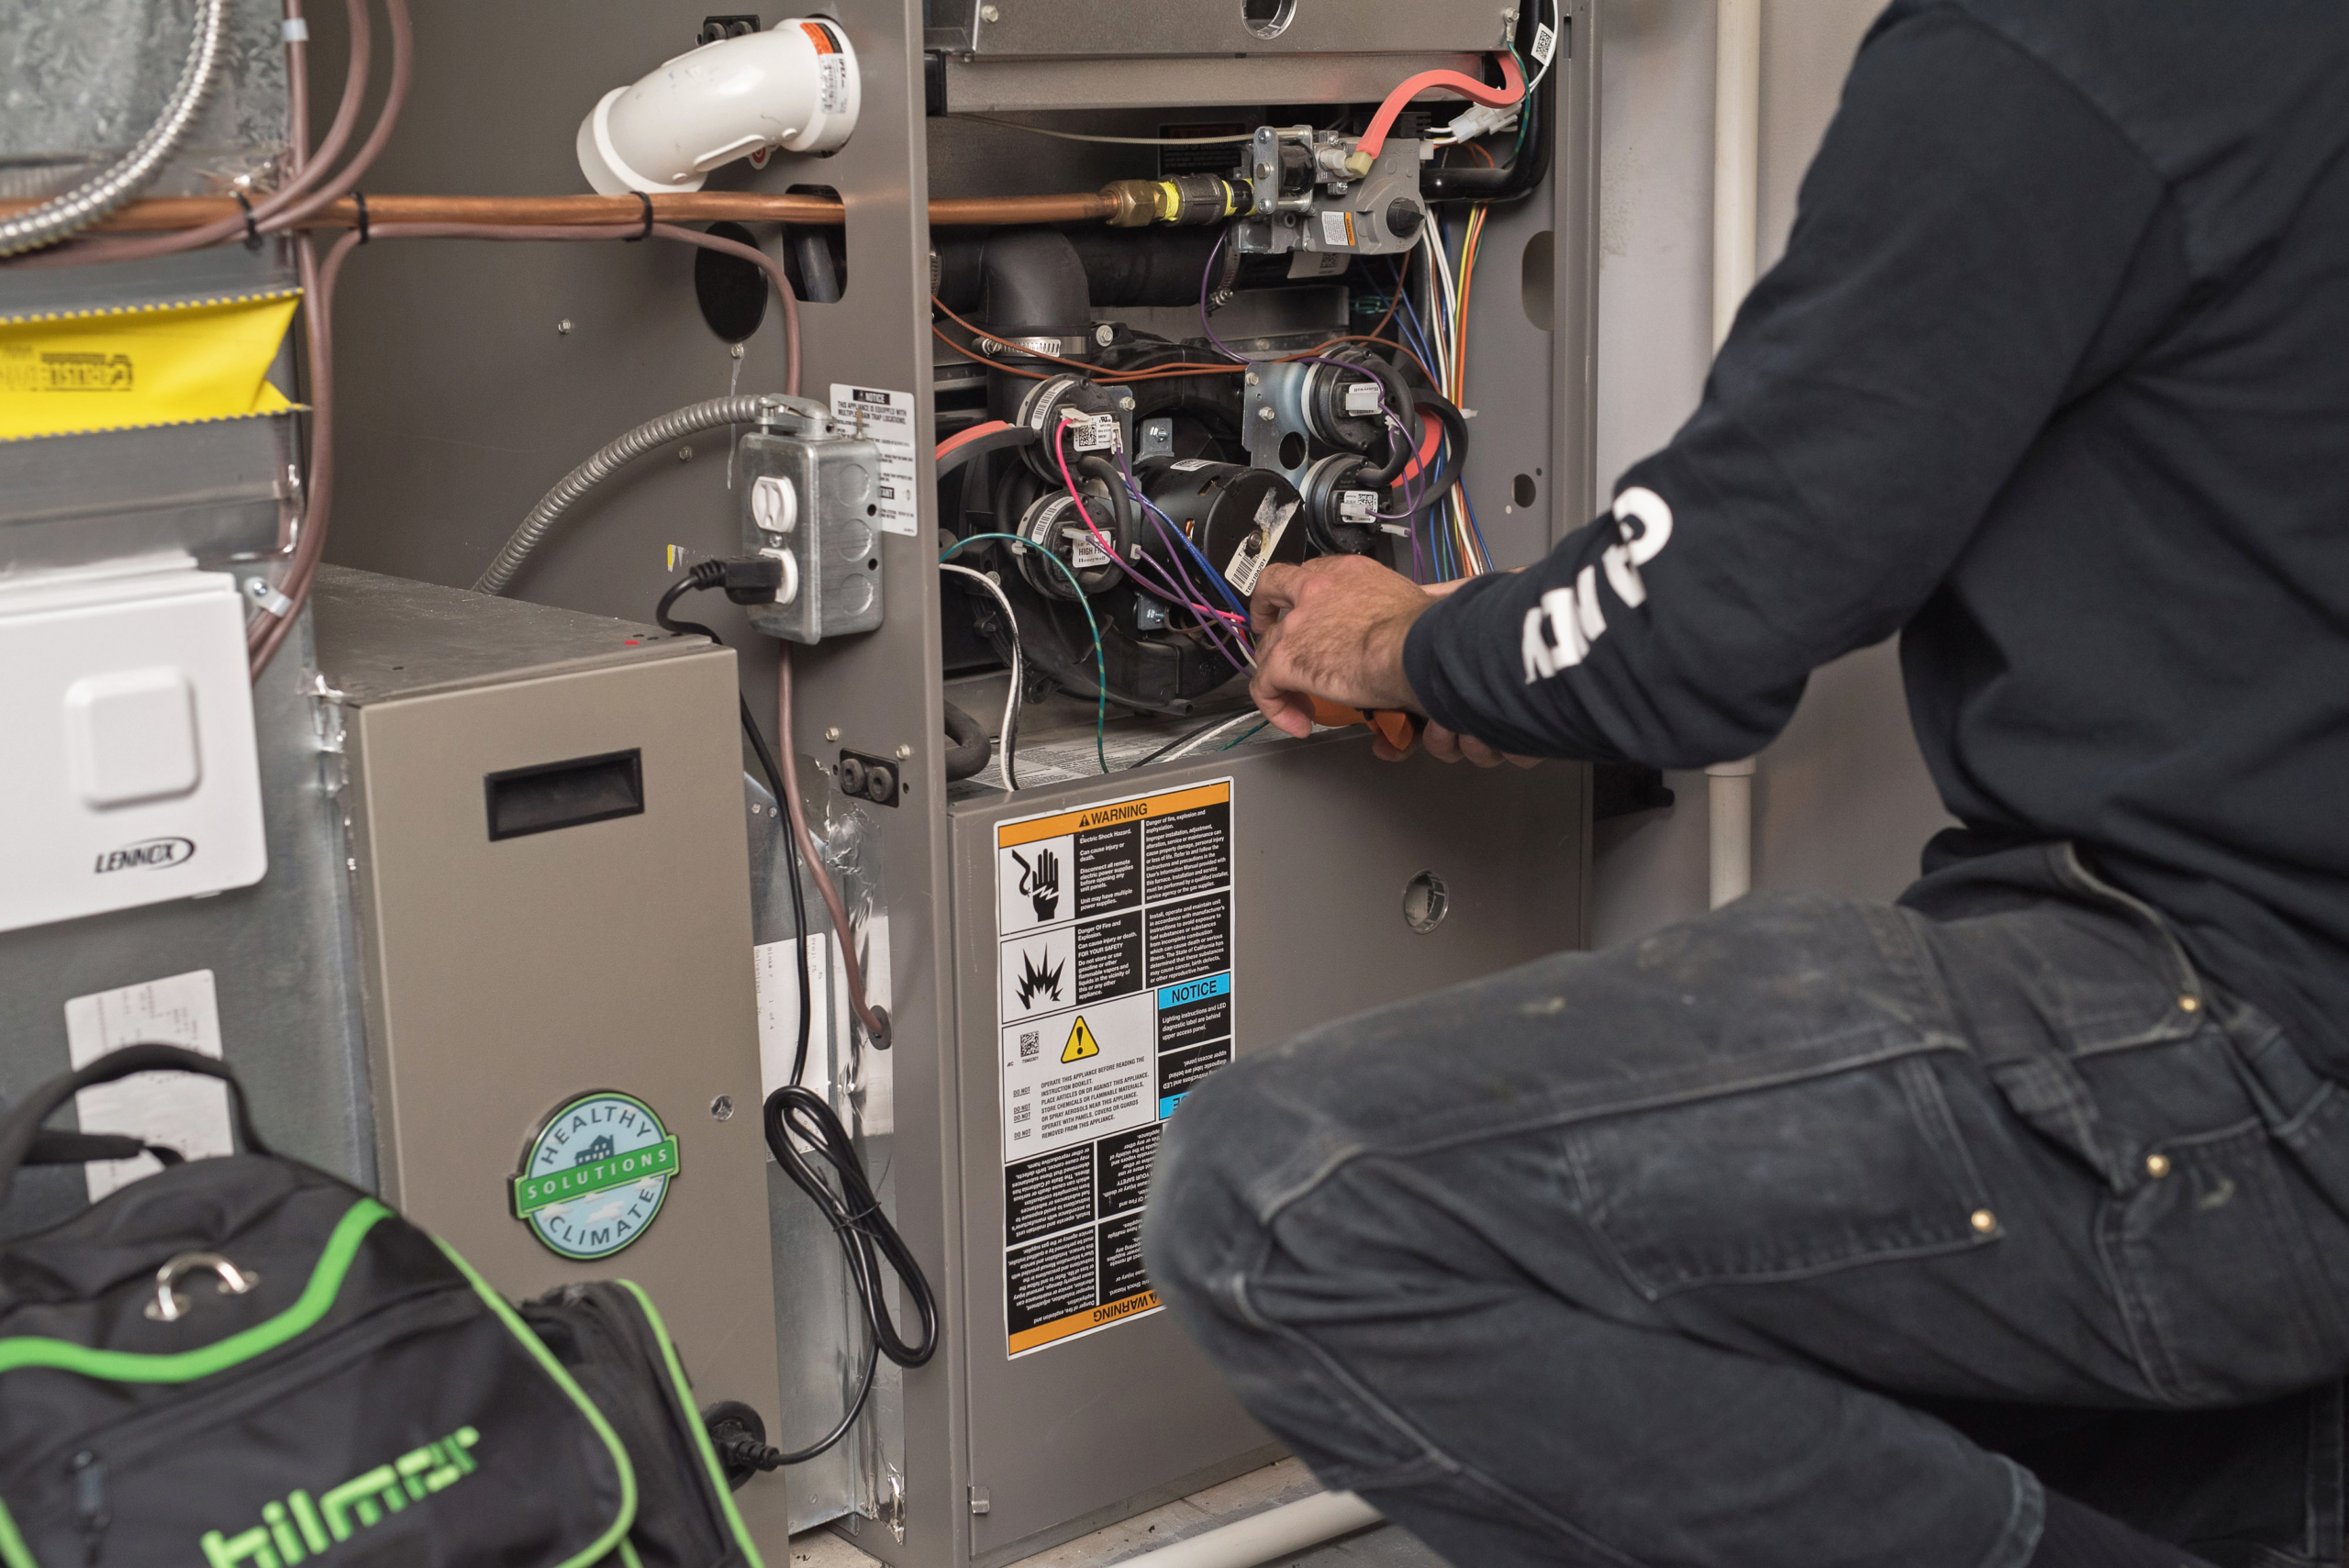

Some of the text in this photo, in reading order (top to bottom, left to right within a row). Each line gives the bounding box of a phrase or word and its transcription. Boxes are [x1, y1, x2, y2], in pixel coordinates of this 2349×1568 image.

[865, 392, 885, 404] NOTICE
[837, 401, 847, 409] THIS
[848, 402, 869, 411] APPLIANCE
[870, 405, 874, 413] IS
[896, 408, 907, 417] WITH
[872, 413, 882, 421] TRAP
[883, 415, 906, 424] LOCATIONS.
[1079, 548, 1094, 556] HIGH
[1091, 803, 1147, 825] WARNING
[1079, 834, 1097, 844] Electric
[1097, 831, 1113, 840] Shock
[95, 842, 176, 873] LENNOX
[1079, 848, 1089, 856] Can
[1105, 842, 1119, 852] injury
[1079, 862, 1107, 874] Disconnect
[1113, 858, 1130, 867] remote
[1079, 863, 1133, 880] electric power supplies
[1080, 877, 1096, 886] before
[1096, 873, 1115, 884] opening
[1080, 887, 1132, 905] Unit may have multiple
[1080, 903, 1096, 912] power
[1077, 925, 1095, 936] Danger
[1077, 941, 1087, 950] Can
[1103, 935, 1116, 945] injury
[1077, 941, 1123, 958] FOR YOUR SAFETY
[1078, 962, 1097, 974] gasoline
[1104, 958, 1117, 966] other
[1094, 953, 1107, 962] store
[1078, 968, 1102, 979] flammable
[1103, 965, 1119, 975] vapors
[1078, 976, 1094, 987] liquids
[1108, 970, 1124, 981] vicinity
[1078, 984, 1087, 993] this
[1094, 983, 1103, 991] any
[1103, 978, 1116, 986] other
[1172, 979, 1217, 1003] NOTICE
[1162, 1001, 1226, 1025] Lighting instructions and LED
[1162, 1020, 1186, 1033] diagnostic
[1186, 1017, 1197, 1026] label
[1205, 1011, 1220, 1021] behind
[1162, 1023, 1206, 1041] upper access panel.
[1041, 1055, 1144, 1088] OPERATE THIS APPLIANCE BEFORE READING THE
[1020, 1085, 1030, 1094] NOT
[1041, 1077, 1093, 1096] INSTRUCTION BOOKLET.
[1041, 1071, 1149, 1106] PLACE ARTICLES ON OR AGAINST THIS APPLIANCE.
[1041, 1081, 1143, 1114] STORE CHEMICALS OR FLAMMABLE MATERIALS,
[1013, 1103, 1030, 1113] DO NOT
[1020, 1111, 1030, 1119] NOT
[1041, 1091, 1137, 1122] OR SPRAY AEROSOLS NEAR THIS APPLIANCE.
[1041, 1118, 1061, 1130] OPERATE
[1062, 1116, 1074, 1125] WITH
[1074, 1110, 1093, 1122] PANELS,
[1094, 1106, 1112, 1116] COVERS
[1119, 1098, 1138, 1109] GUARDS
[1013, 1128, 1030, 1139] DO NOT
[1041, 1113, 1115, 1139] REMOVED FROM THIS APPLIANCE.
[540, 1106, 653, 1165] HEALTHY
[528, 1149, 667, 1200] SOLUTIONS
[549, 1188, 656, 1247] CLIMATE
[1093, 1294, 1147, 1323] WARNING
